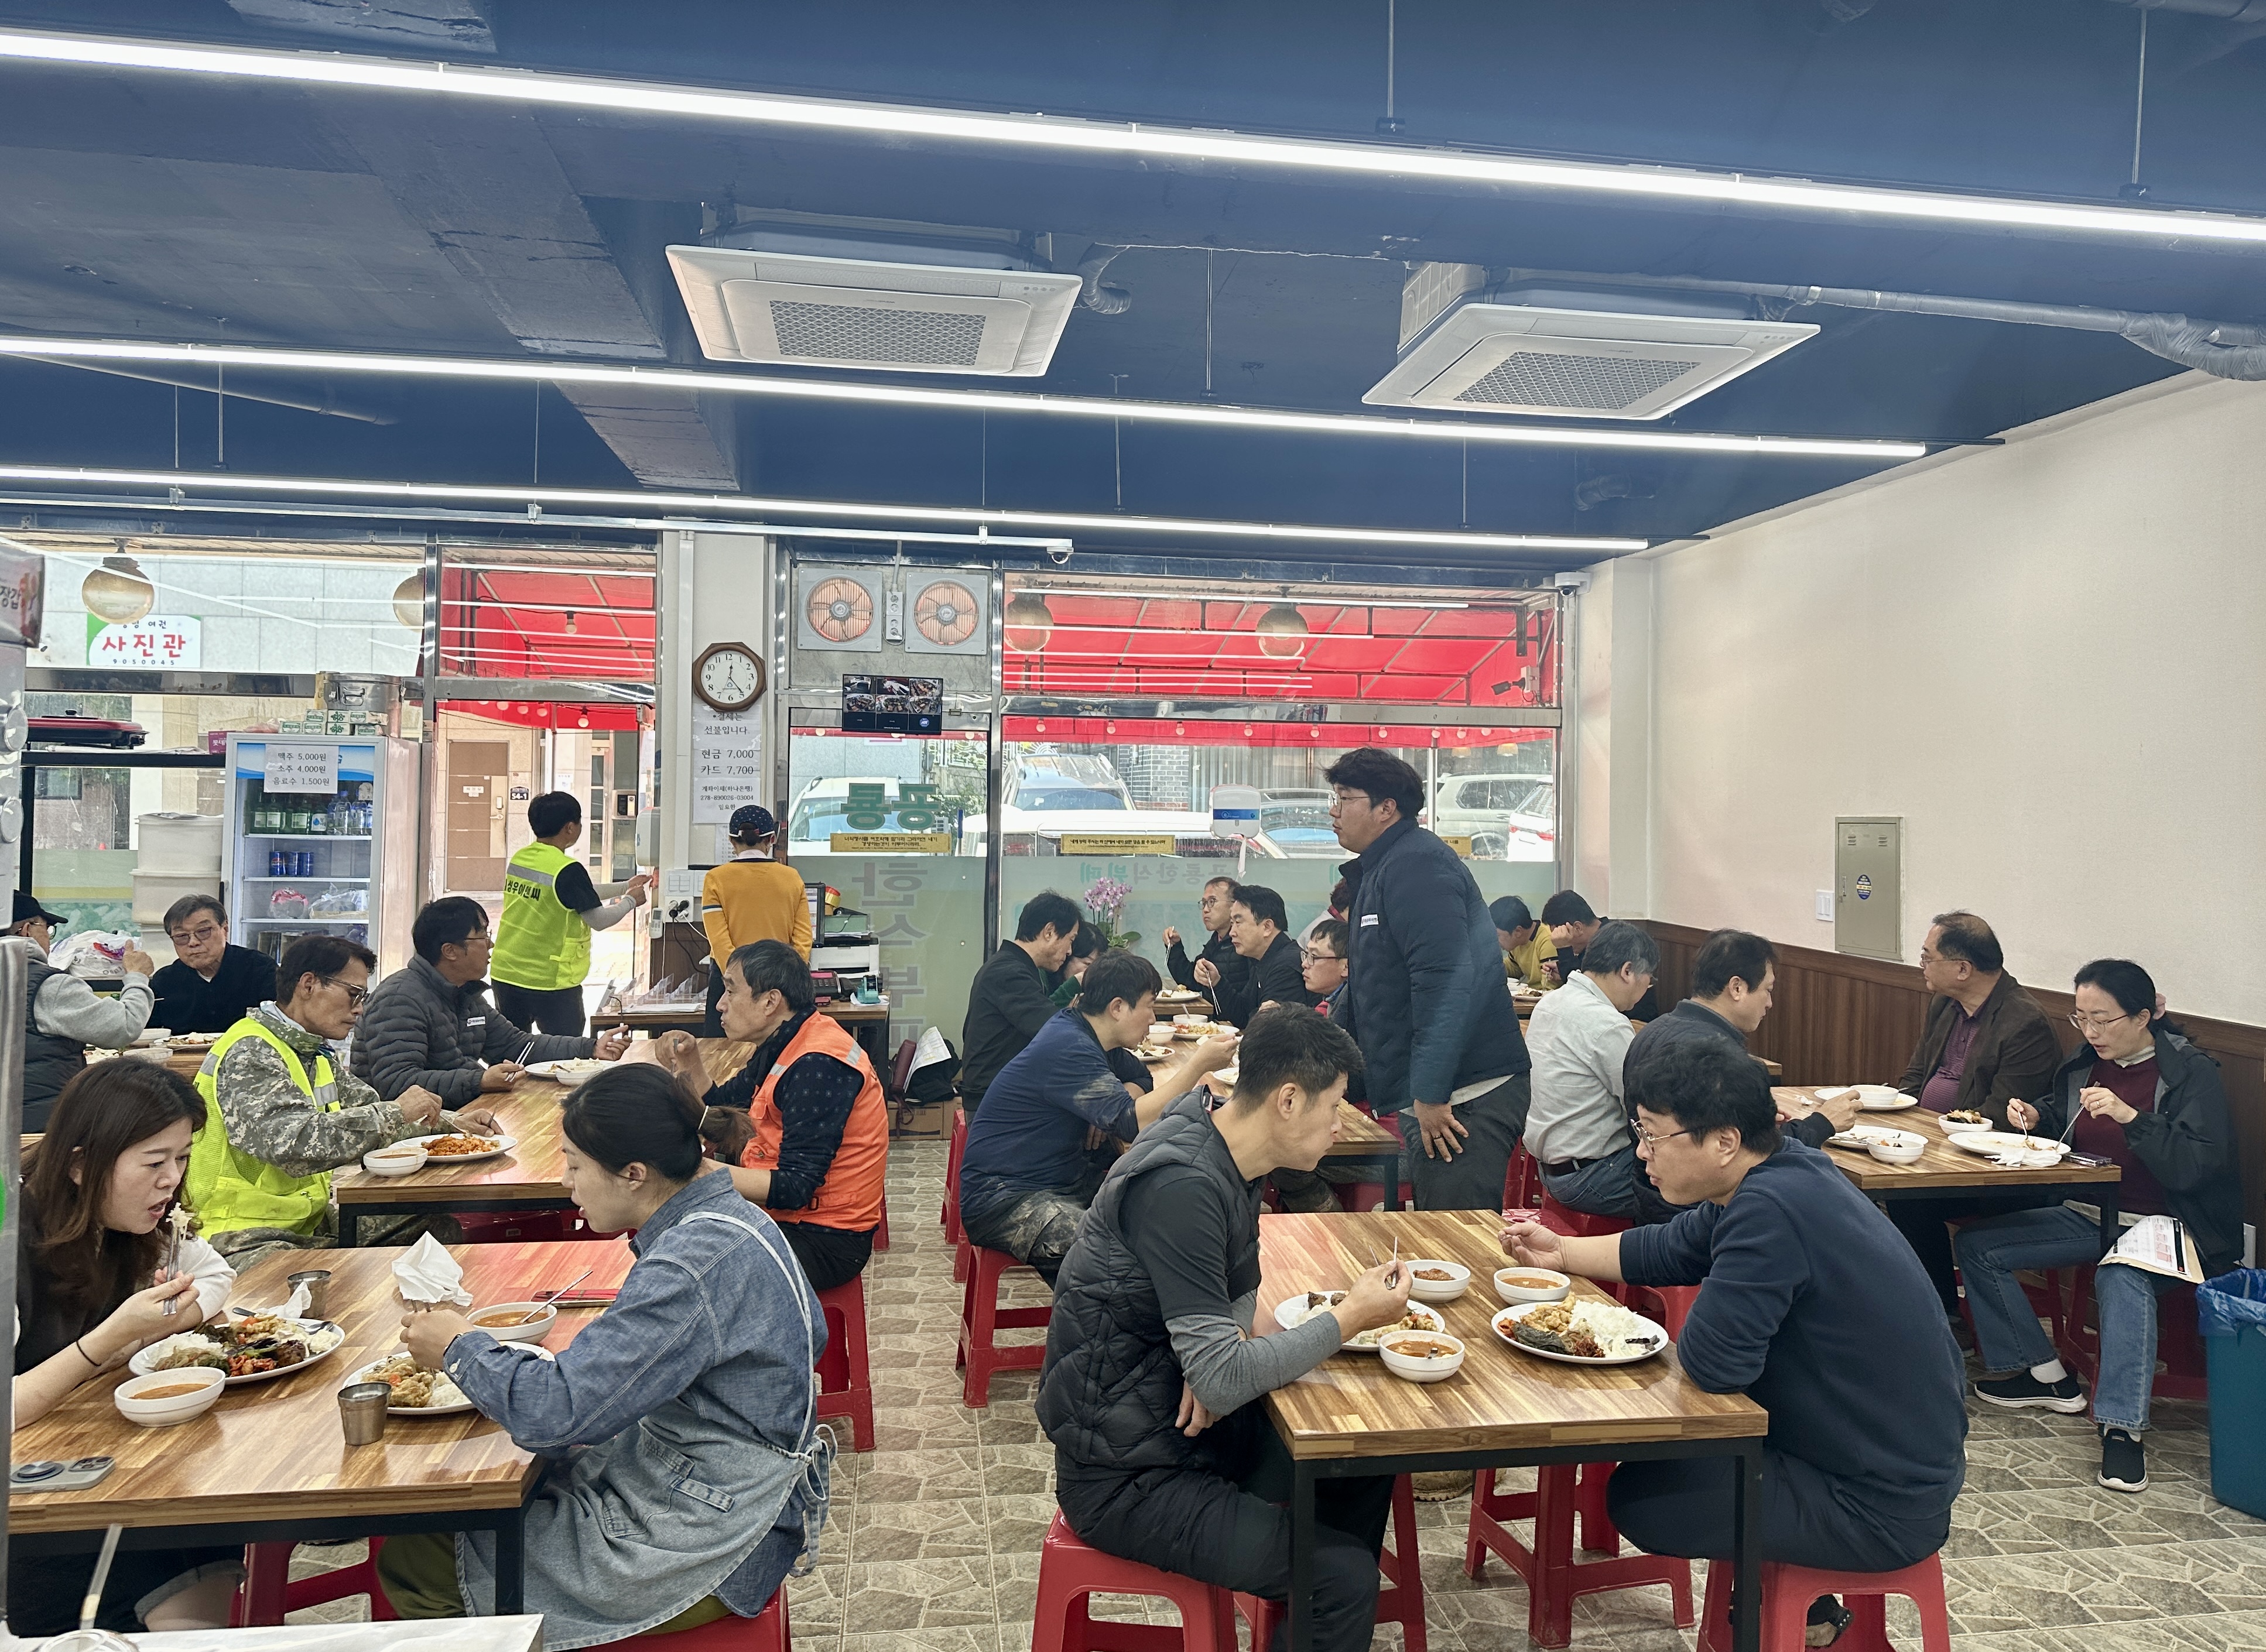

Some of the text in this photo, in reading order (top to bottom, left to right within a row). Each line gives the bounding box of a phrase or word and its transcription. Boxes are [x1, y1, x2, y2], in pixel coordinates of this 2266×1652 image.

[148, 621, 166, 629] 여권
[102, 634, 186, 658] 사진관
[278, 753, 326, 762] 맥주 5,000원
[701, 749, 754, 759] 현금 7,000
[278, 765, 326, 774] 소주 4,000원
[701, 765, 754, 775] 카드 7,700
[272, 777, 330, 786] 음료수 1,500원
